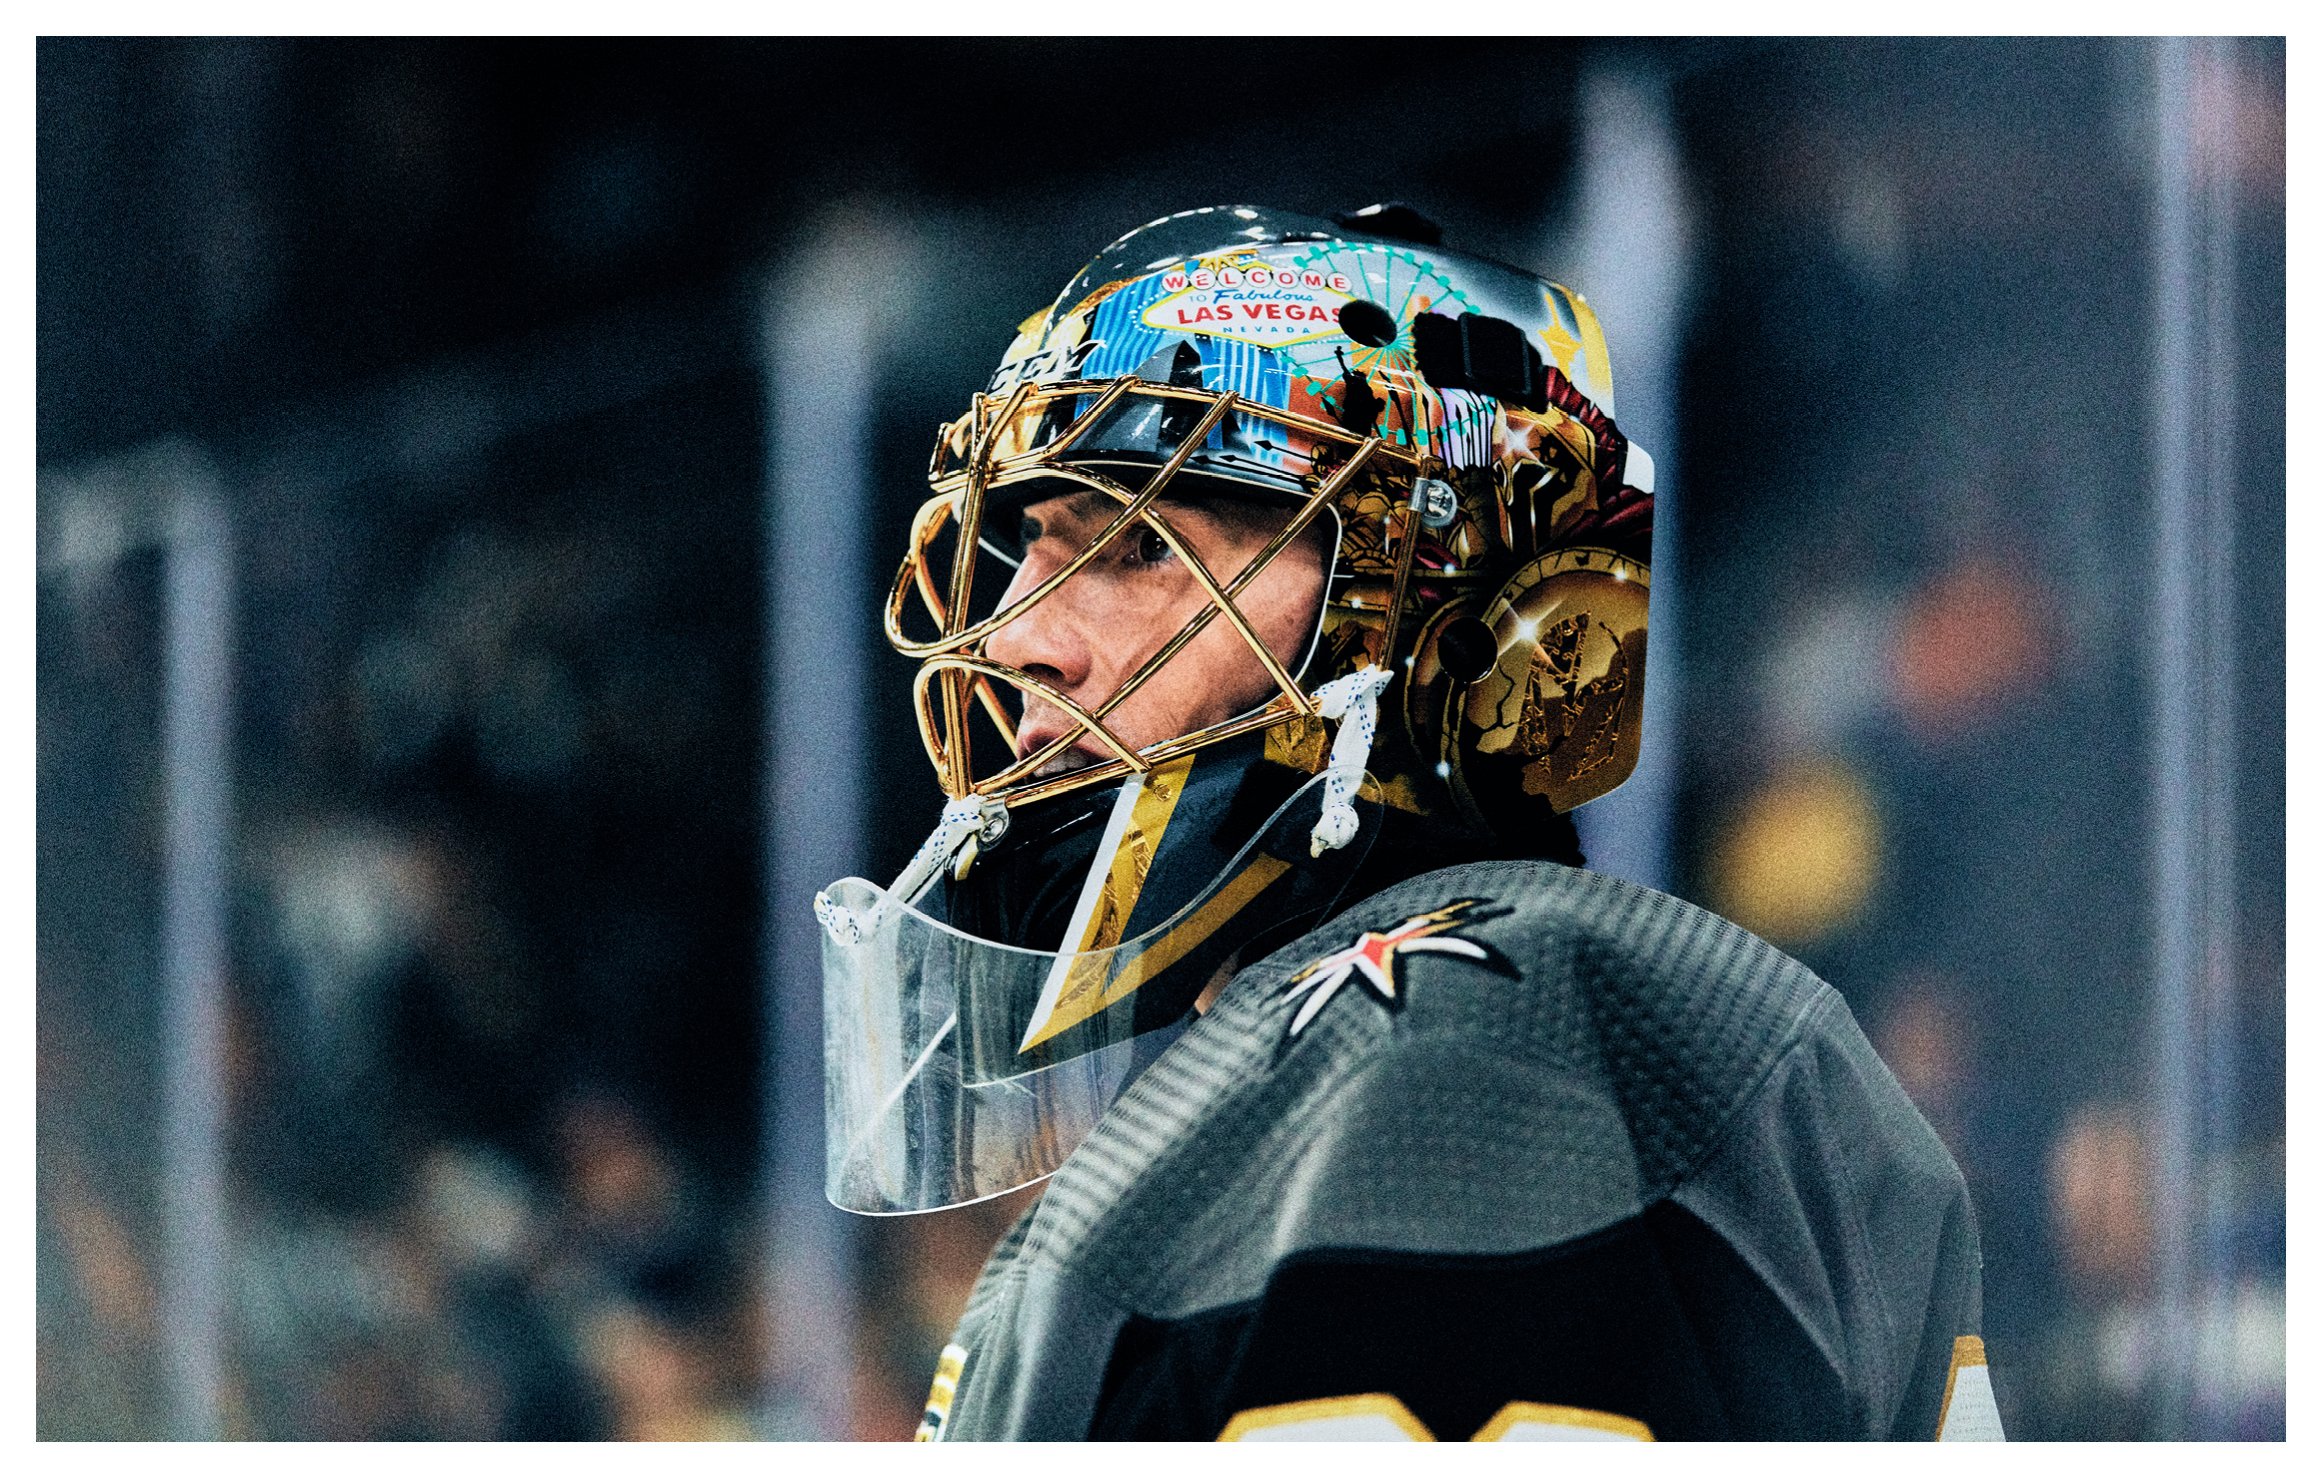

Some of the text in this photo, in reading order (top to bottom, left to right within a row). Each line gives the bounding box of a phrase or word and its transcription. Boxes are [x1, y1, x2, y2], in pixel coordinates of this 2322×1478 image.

[1164, 270, 1347, 290] WELCOME
[1212, 289, 1315, 304] Fabulous
[1177, 304, 1234, 325] LAS
[1222, 325, 1311, 335] NEVADA
